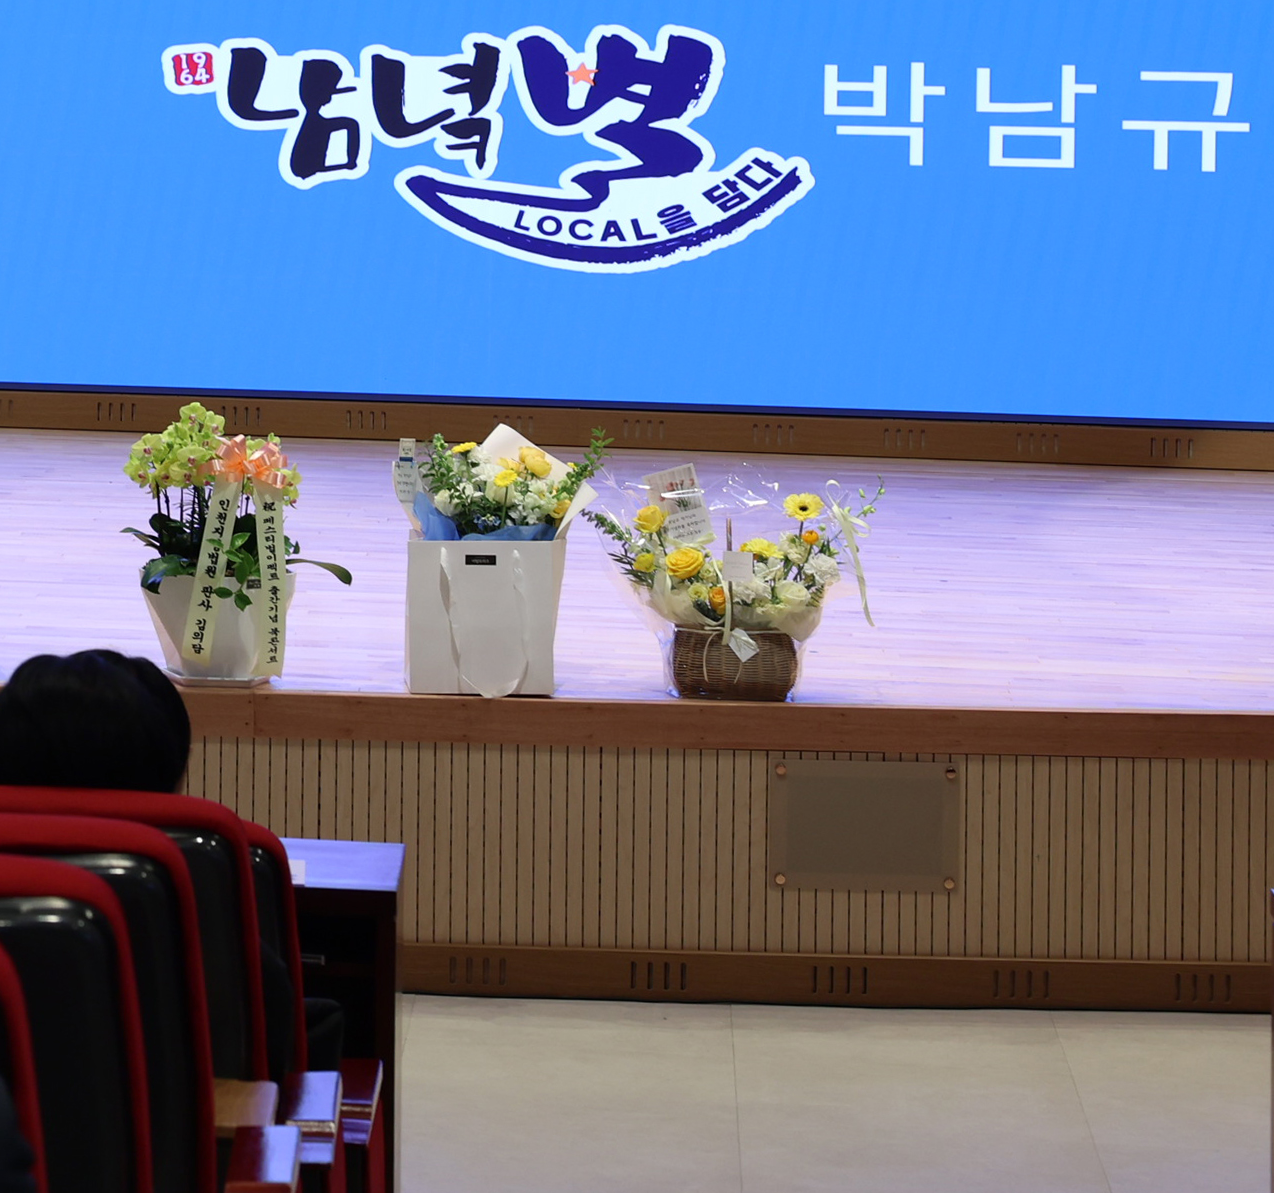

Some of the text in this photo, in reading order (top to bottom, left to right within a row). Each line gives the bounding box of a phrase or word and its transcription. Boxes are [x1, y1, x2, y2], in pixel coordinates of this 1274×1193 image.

[514, 157, 784, 242] LOCAL을 담다
[197, 585, 215, 612] 판사
